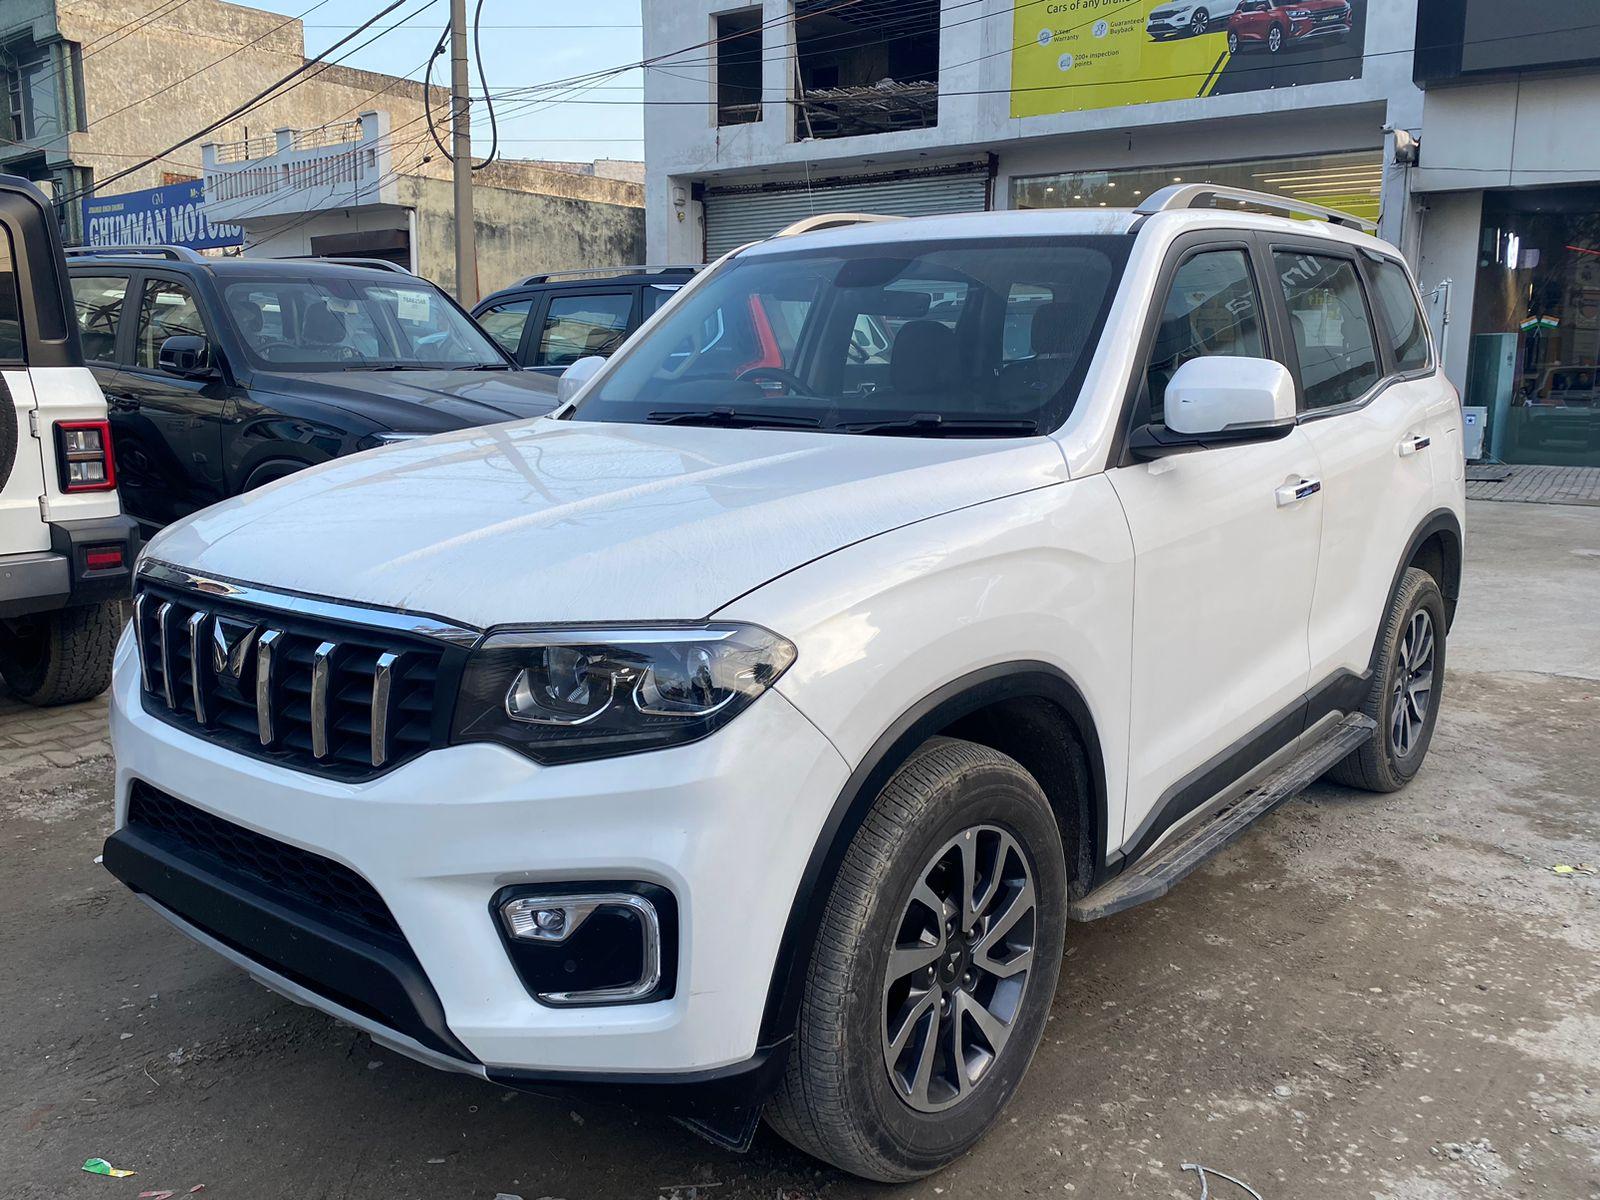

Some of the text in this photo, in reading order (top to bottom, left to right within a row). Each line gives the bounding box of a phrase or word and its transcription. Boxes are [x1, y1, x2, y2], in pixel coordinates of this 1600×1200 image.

[1046, 4, 1067, 14] Cars
[1069, 1, 1080, 11] of
[1082, 0, 1098, 9] any
[1110, 17, 1145, 27] Guaranteed
[1110, 26, 1134, 34] Buyback
[1054, 34, 1079, 42] Warranty
[1089, 50, 1119, 59] inspection
[89, 207, 167, 246] GHUMMAN
